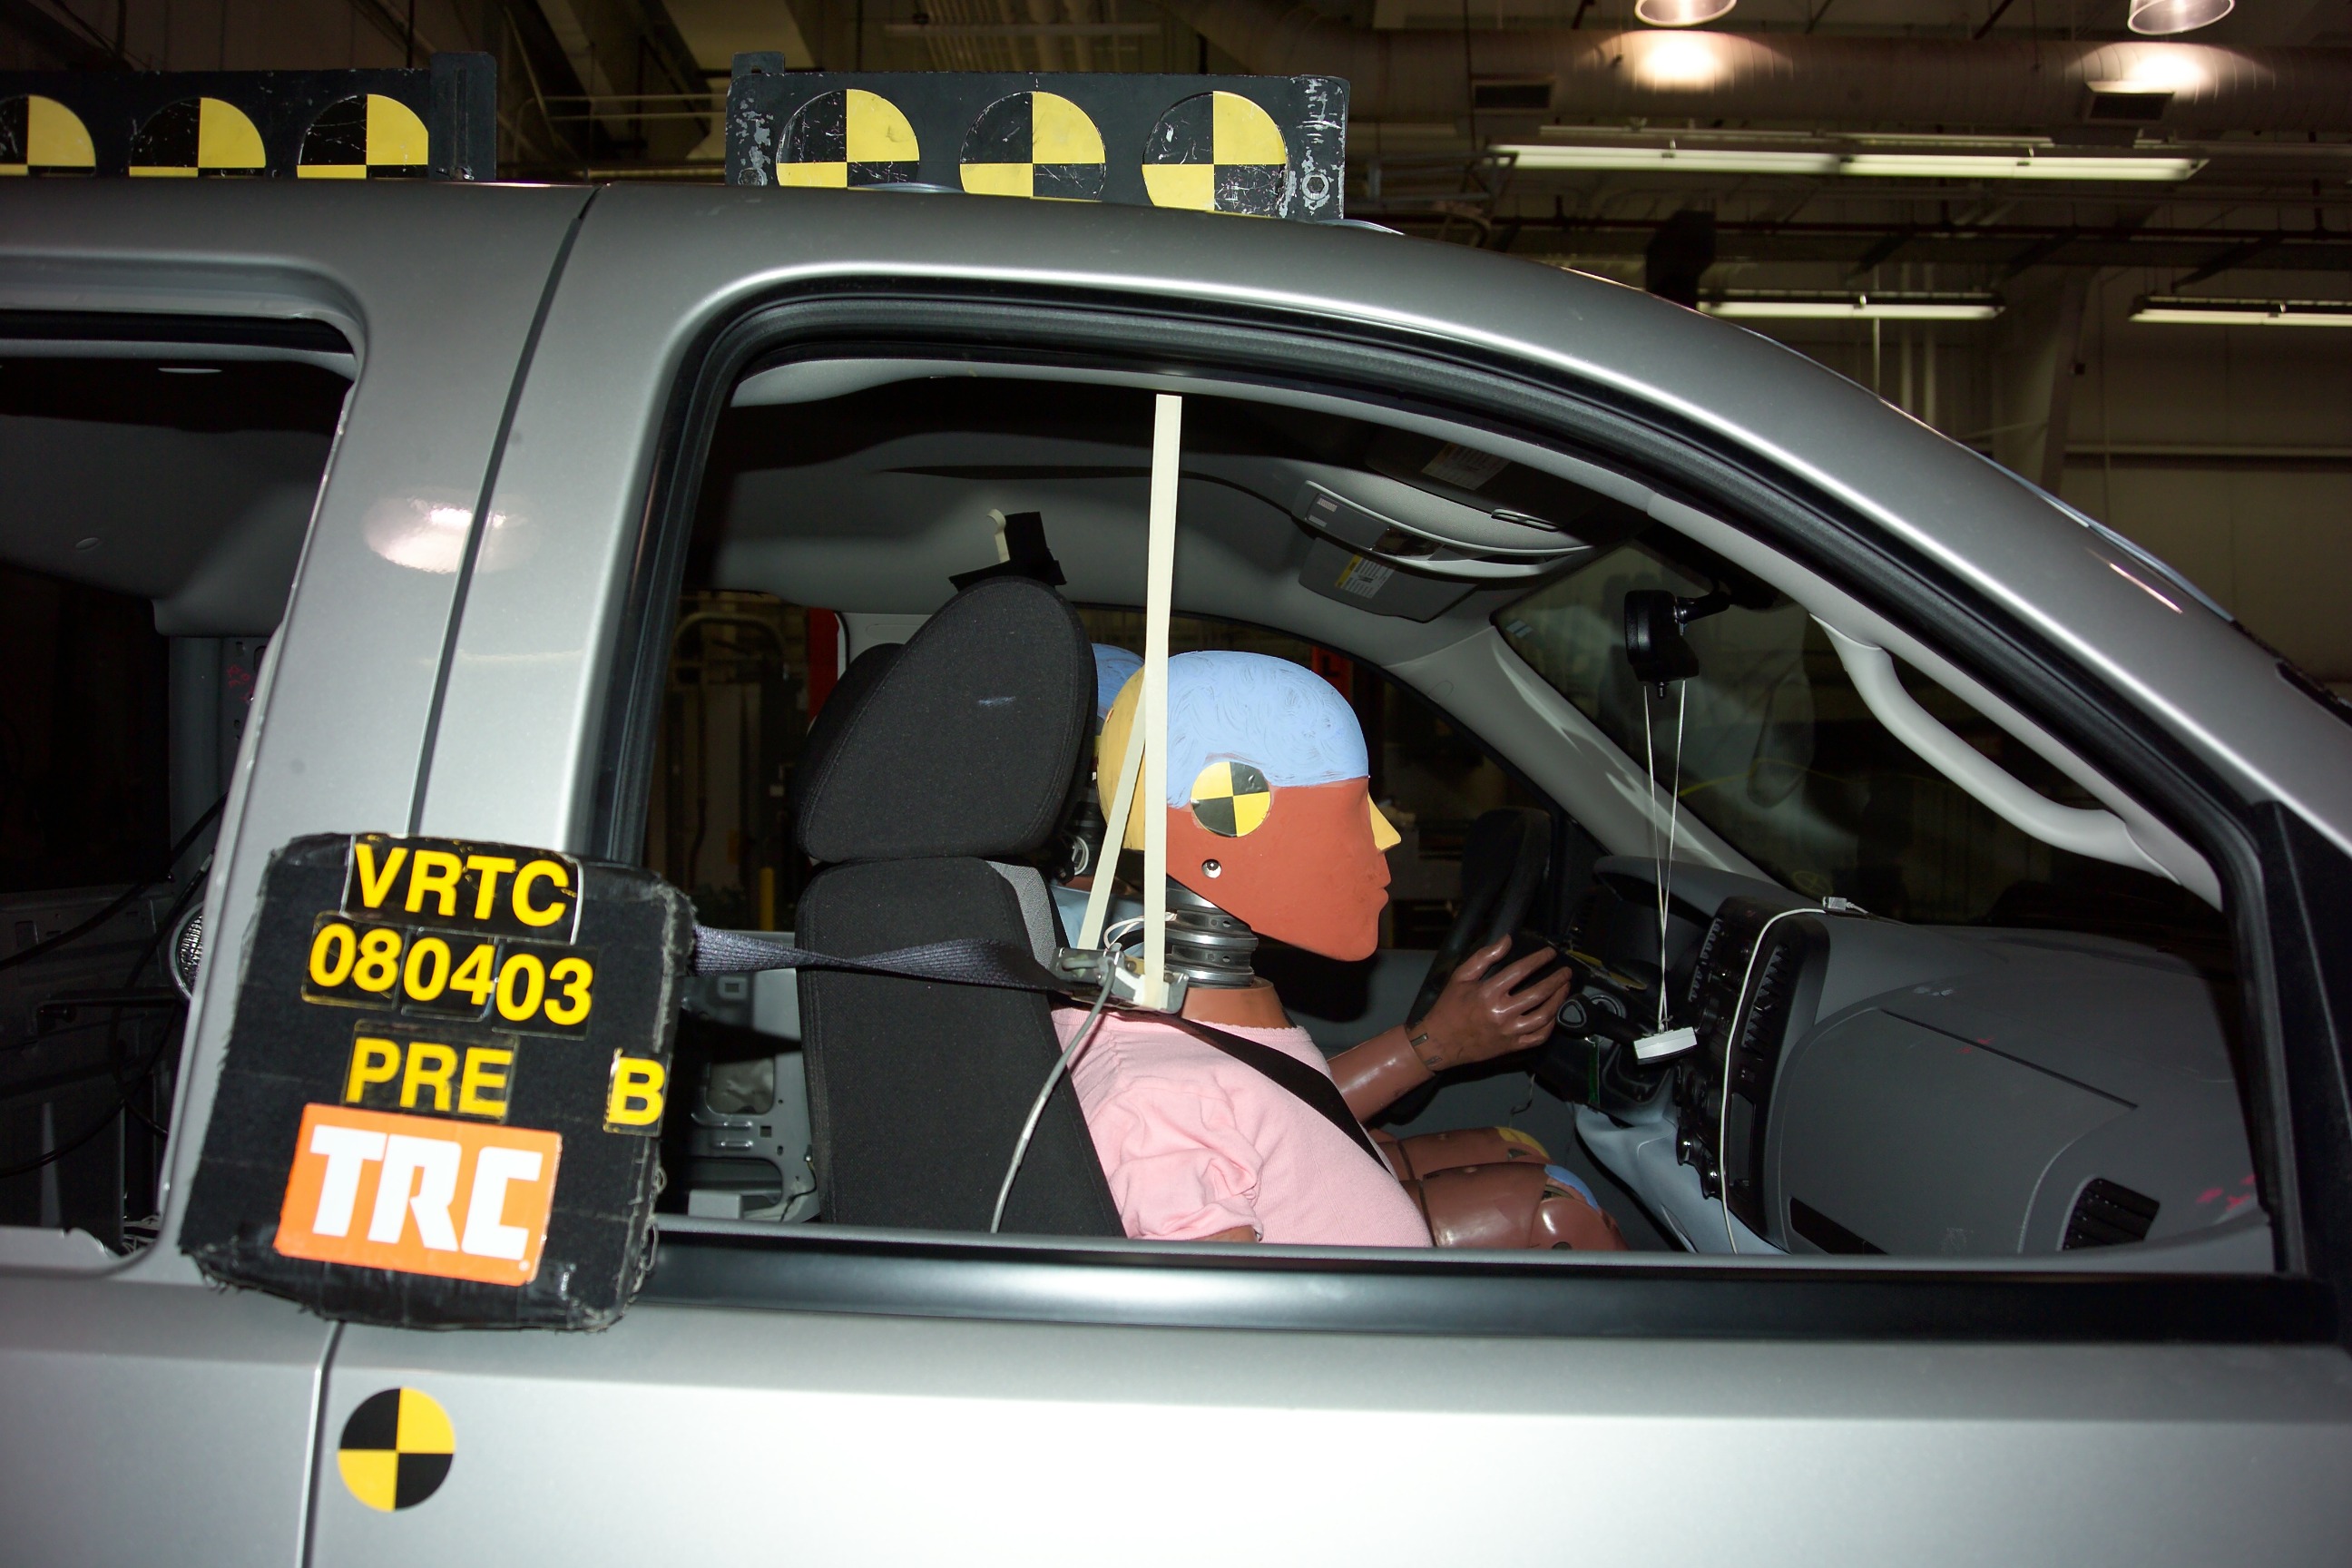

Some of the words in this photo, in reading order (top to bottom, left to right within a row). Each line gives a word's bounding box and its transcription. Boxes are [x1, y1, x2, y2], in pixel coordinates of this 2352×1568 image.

[355, 842, 570, 927] VRTC
[309, 923, 594, 1026] 080403
[345, 1037, 514, 1119] PRE
[606, 1056, 666, 1126] B
[309, 1124, 543, 1260] TRC
